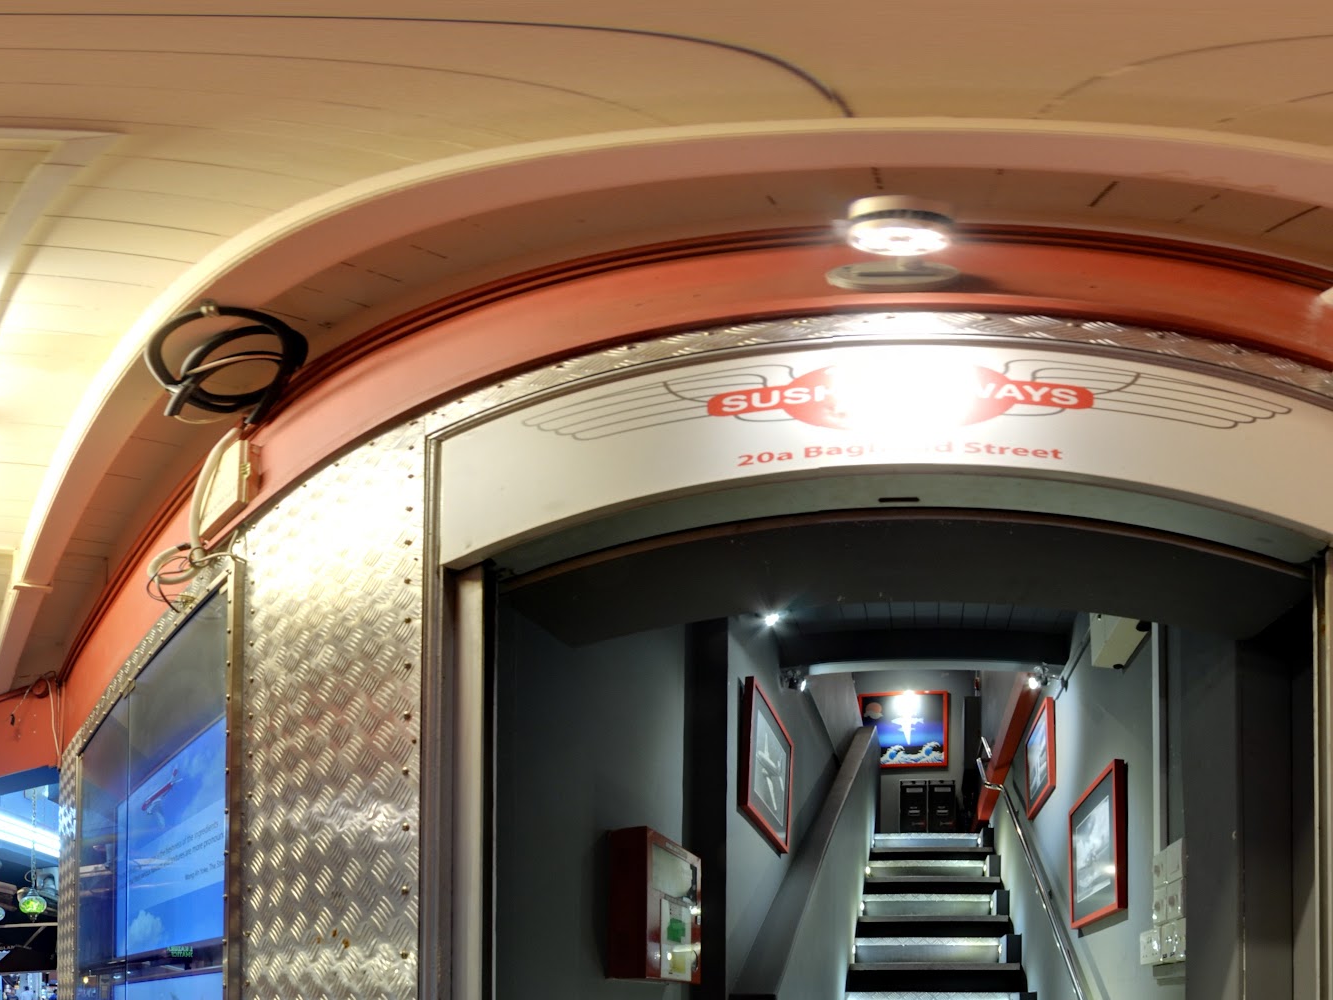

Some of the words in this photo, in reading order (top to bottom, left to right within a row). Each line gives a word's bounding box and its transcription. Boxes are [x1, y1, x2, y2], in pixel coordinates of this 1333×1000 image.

[722, 386, 835, 412] SUSH
[973, 383, 1078, 405] WAYS
[737, 451, 793, 466] 20a
[804, 441, 952, 459] Bagd
[964, 441, 1063, 460] Street
